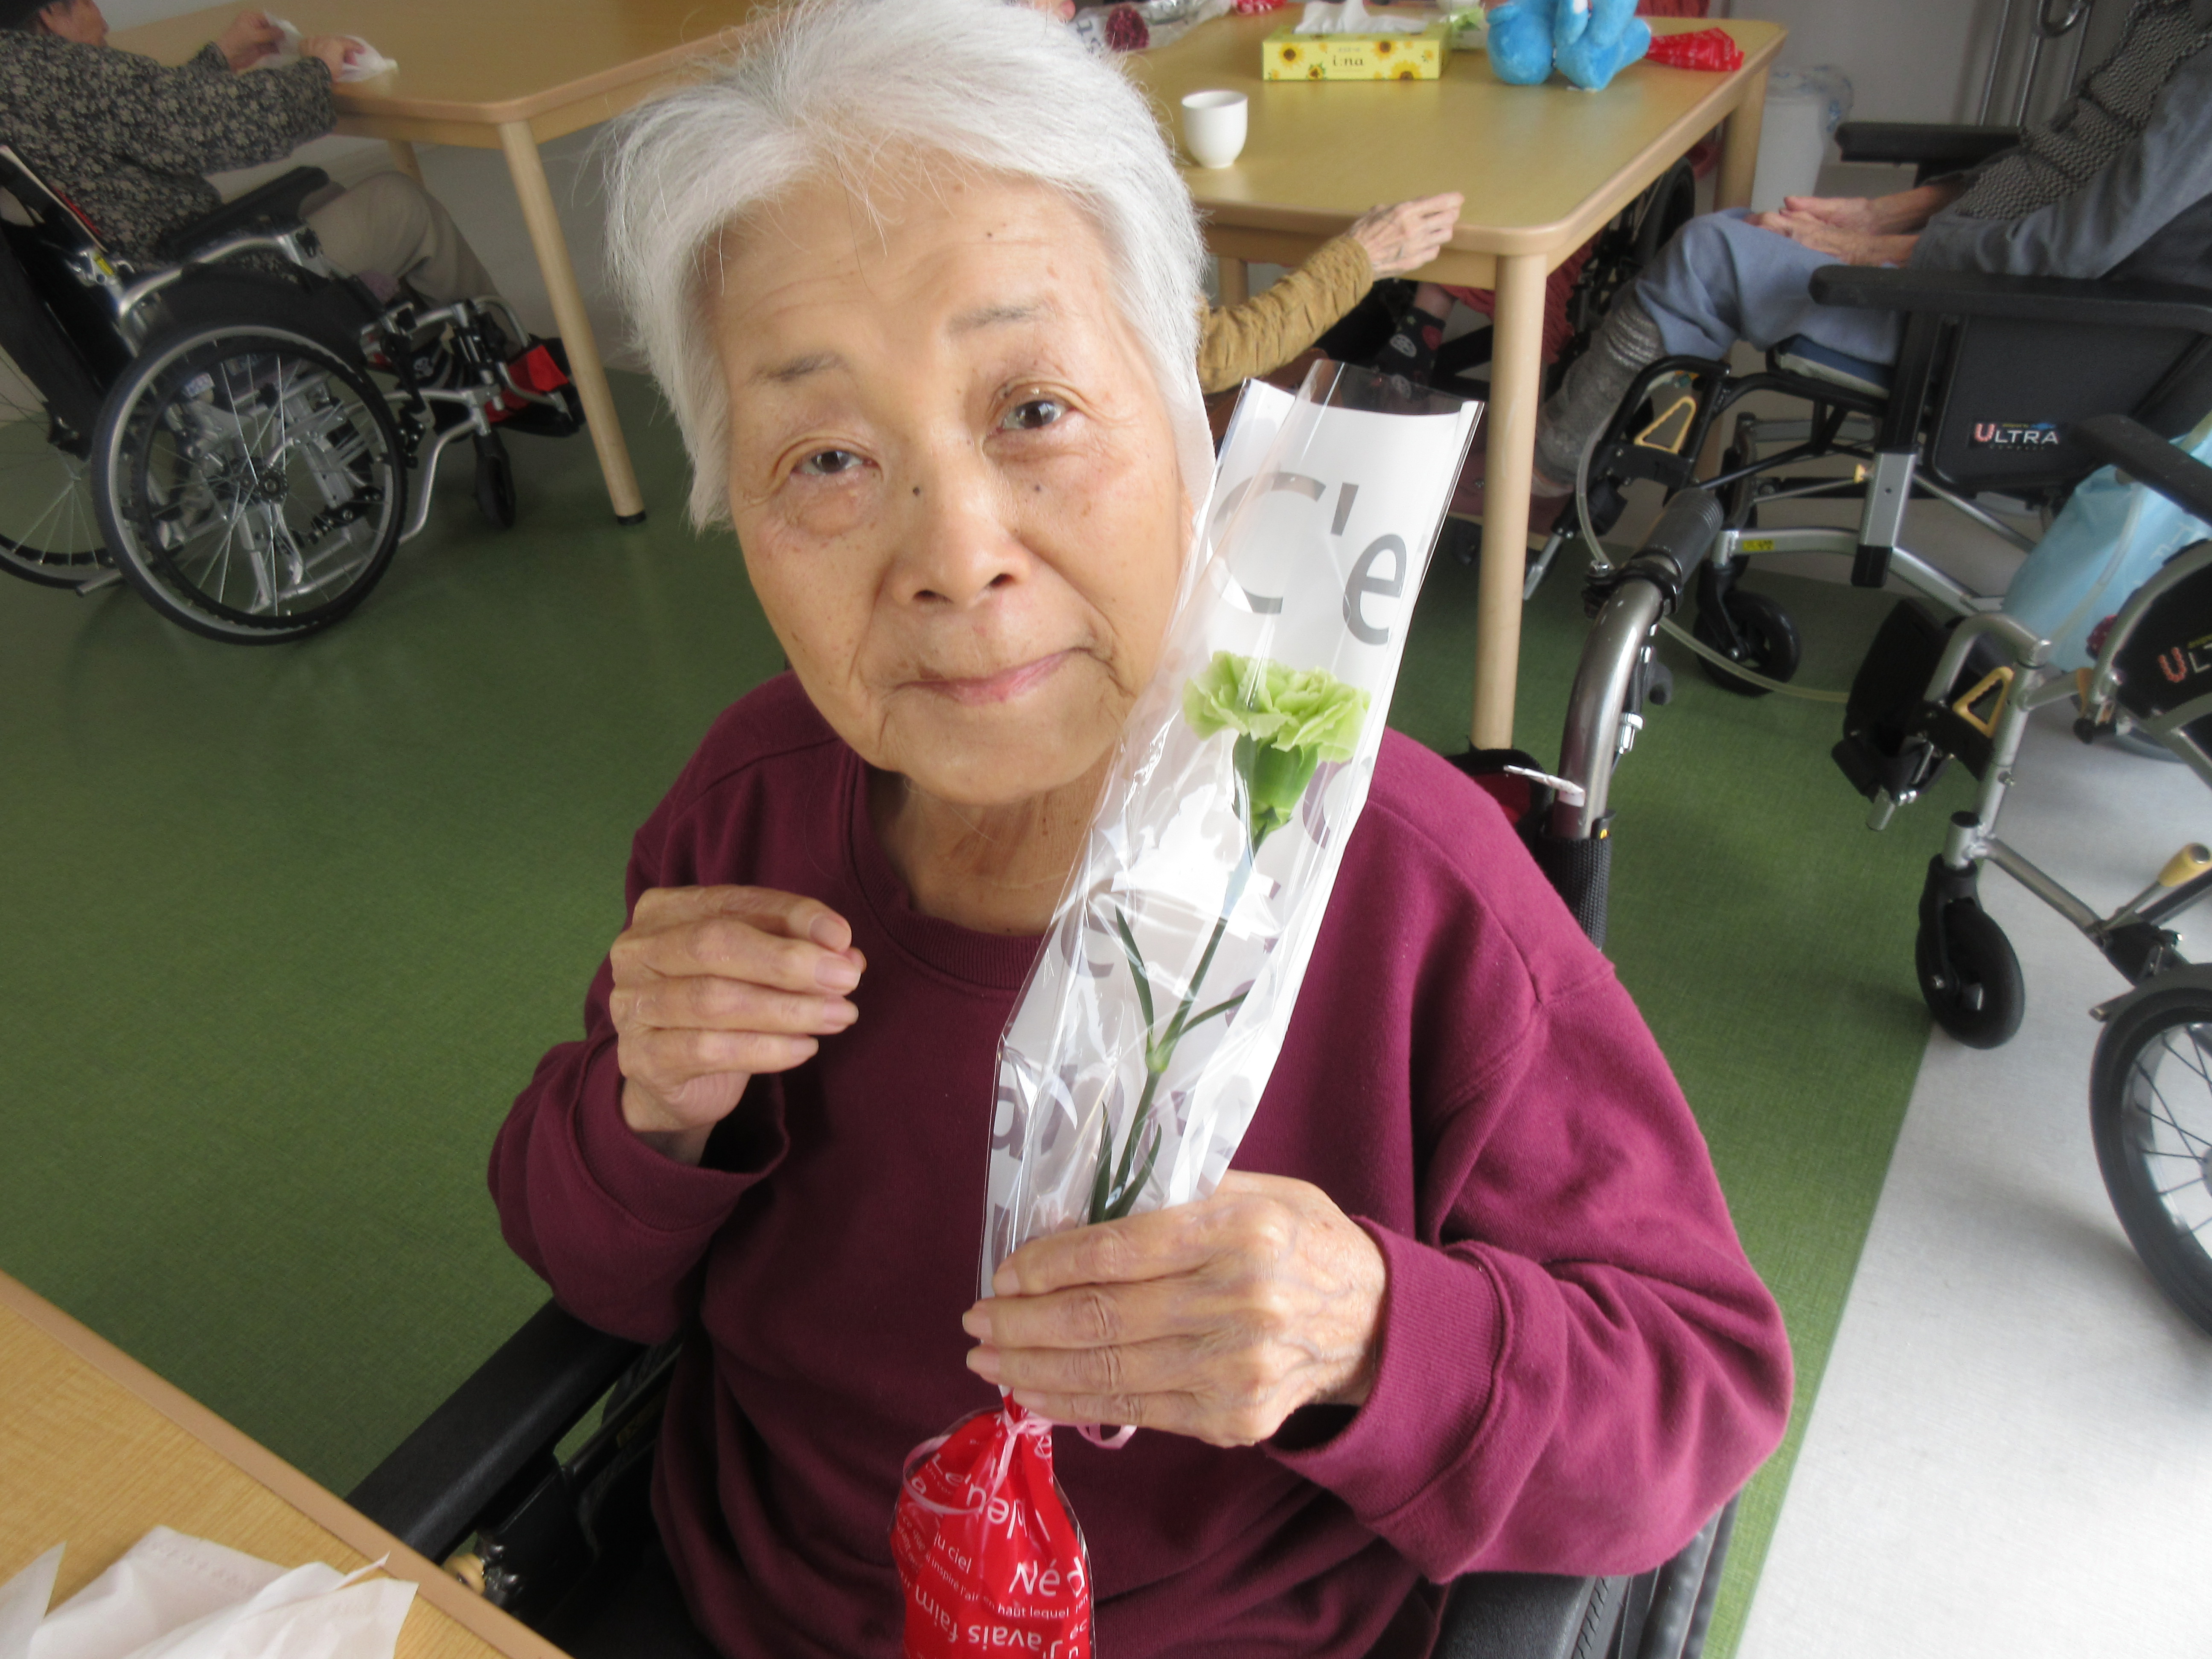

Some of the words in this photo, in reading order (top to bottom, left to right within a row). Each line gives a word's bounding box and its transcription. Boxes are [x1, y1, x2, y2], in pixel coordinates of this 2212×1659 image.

[1974, 423, 2059, 445] ULTRA
[2158, 643, 2212, 683] UL
[948, 1546, 972, 1575] ciel
[915, 1584, 959, 1644] faim
[998, 1603, 1026, 1617] haut
[1030, 1605, 1069, 1620] lequel
